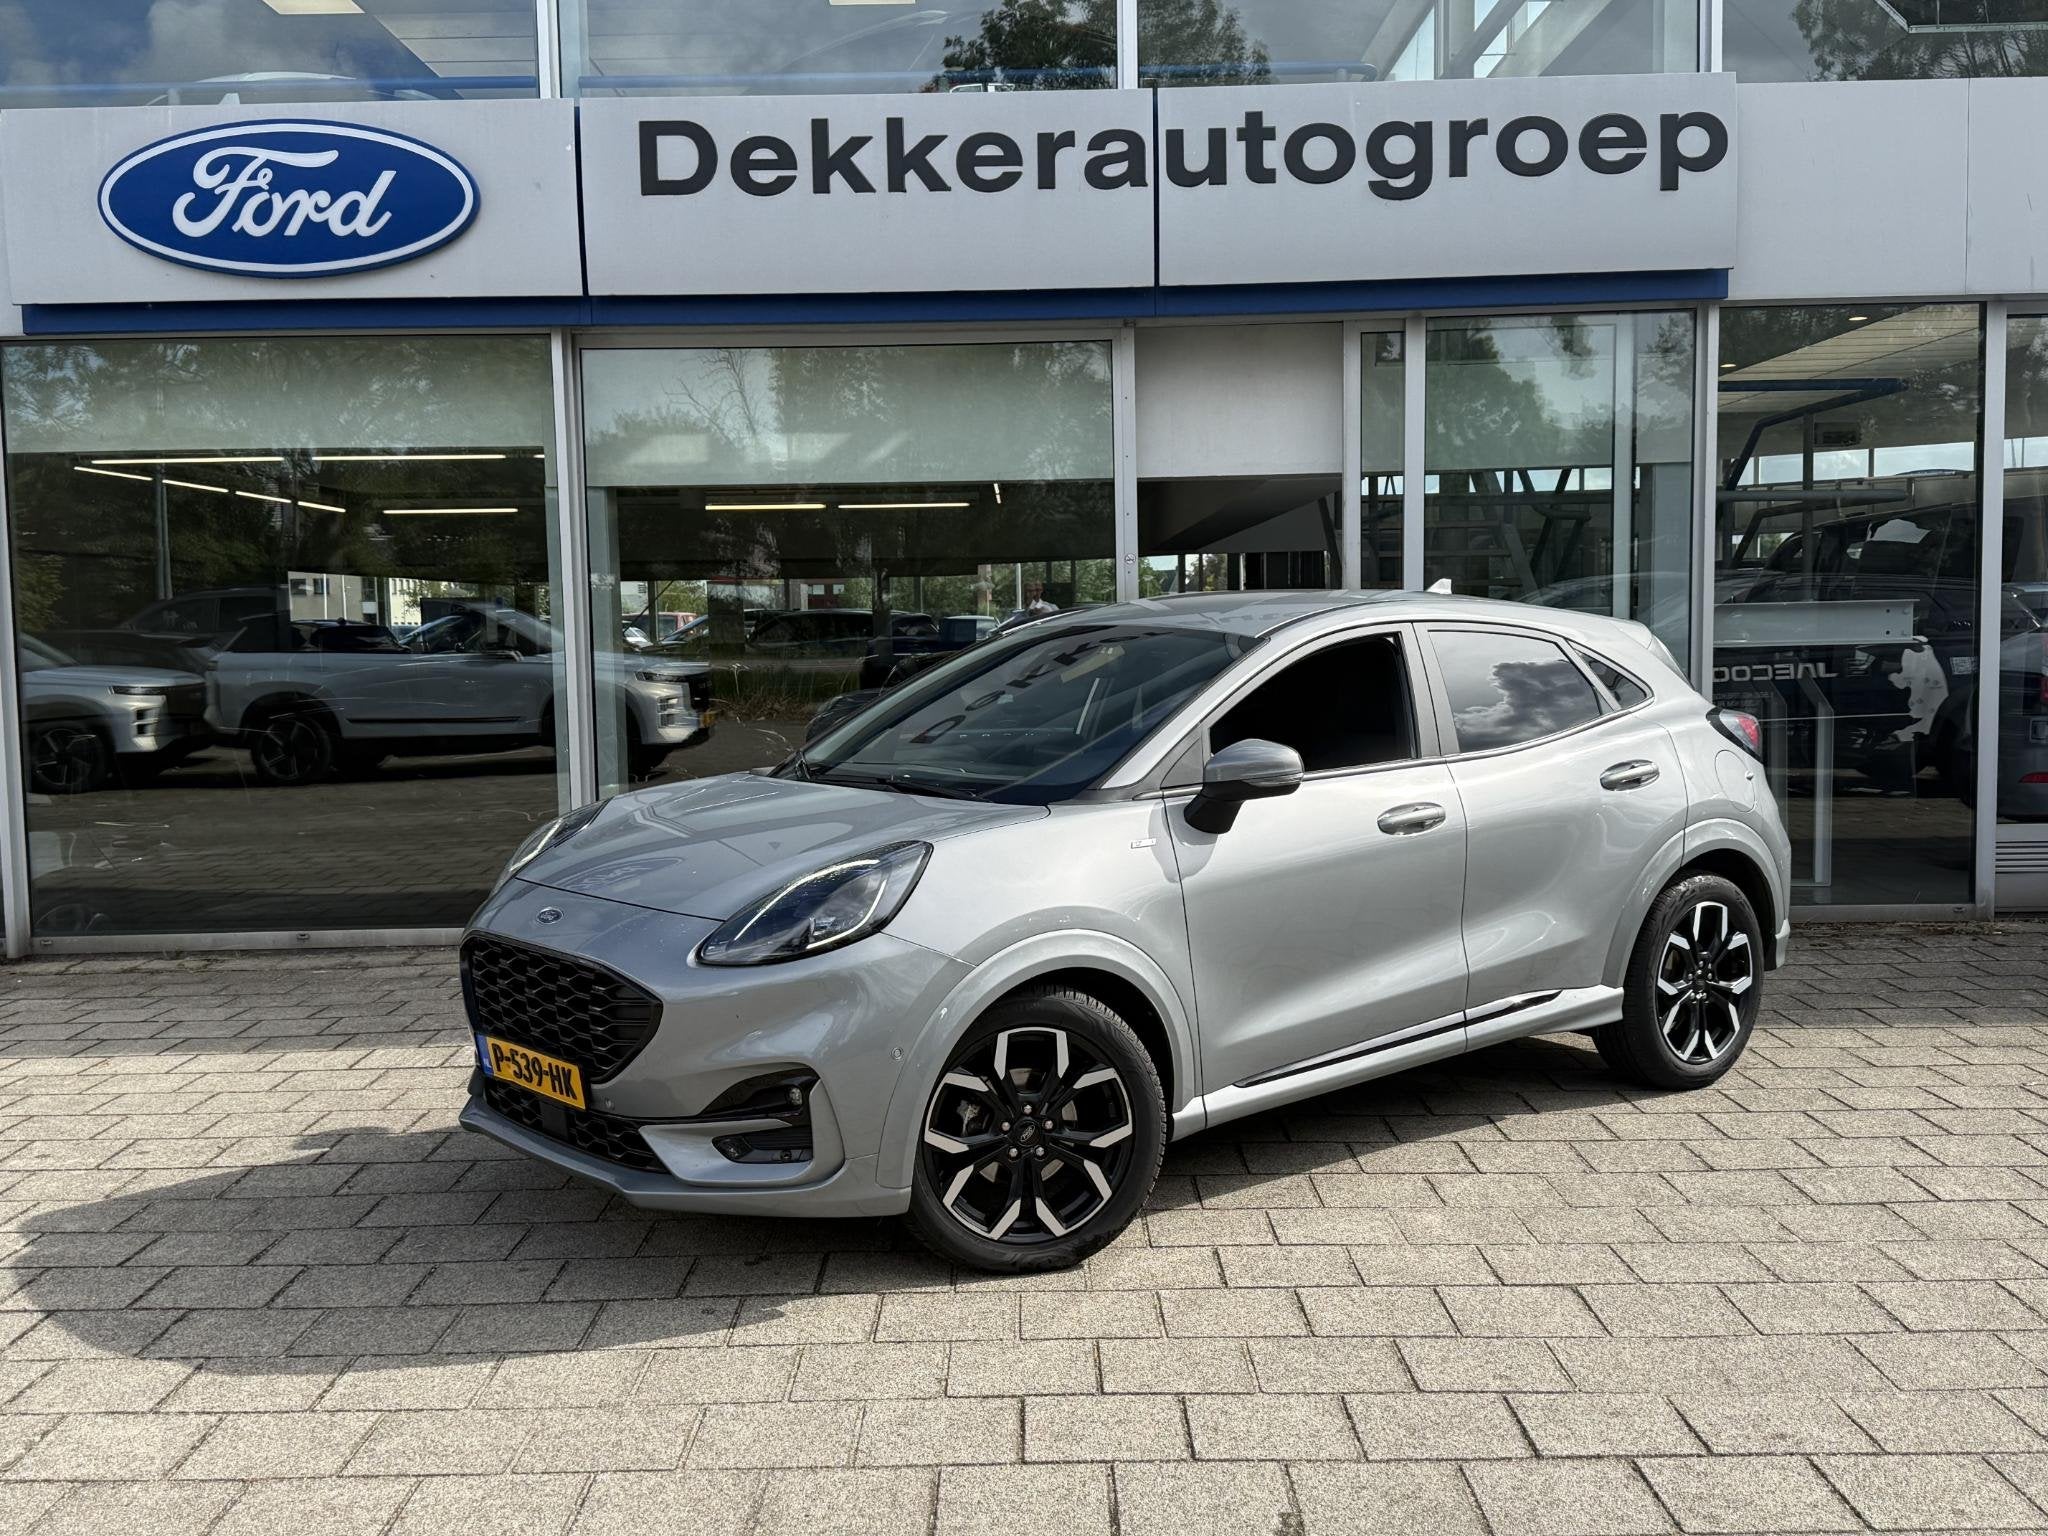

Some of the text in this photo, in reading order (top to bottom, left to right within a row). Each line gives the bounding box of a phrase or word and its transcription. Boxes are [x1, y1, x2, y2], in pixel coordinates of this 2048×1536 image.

[172, 146, 397, 238] Ford
[638, 110, 1730, 201] Dekkerautogroep
[491, 1043, 578, 1101] P-539-HK
